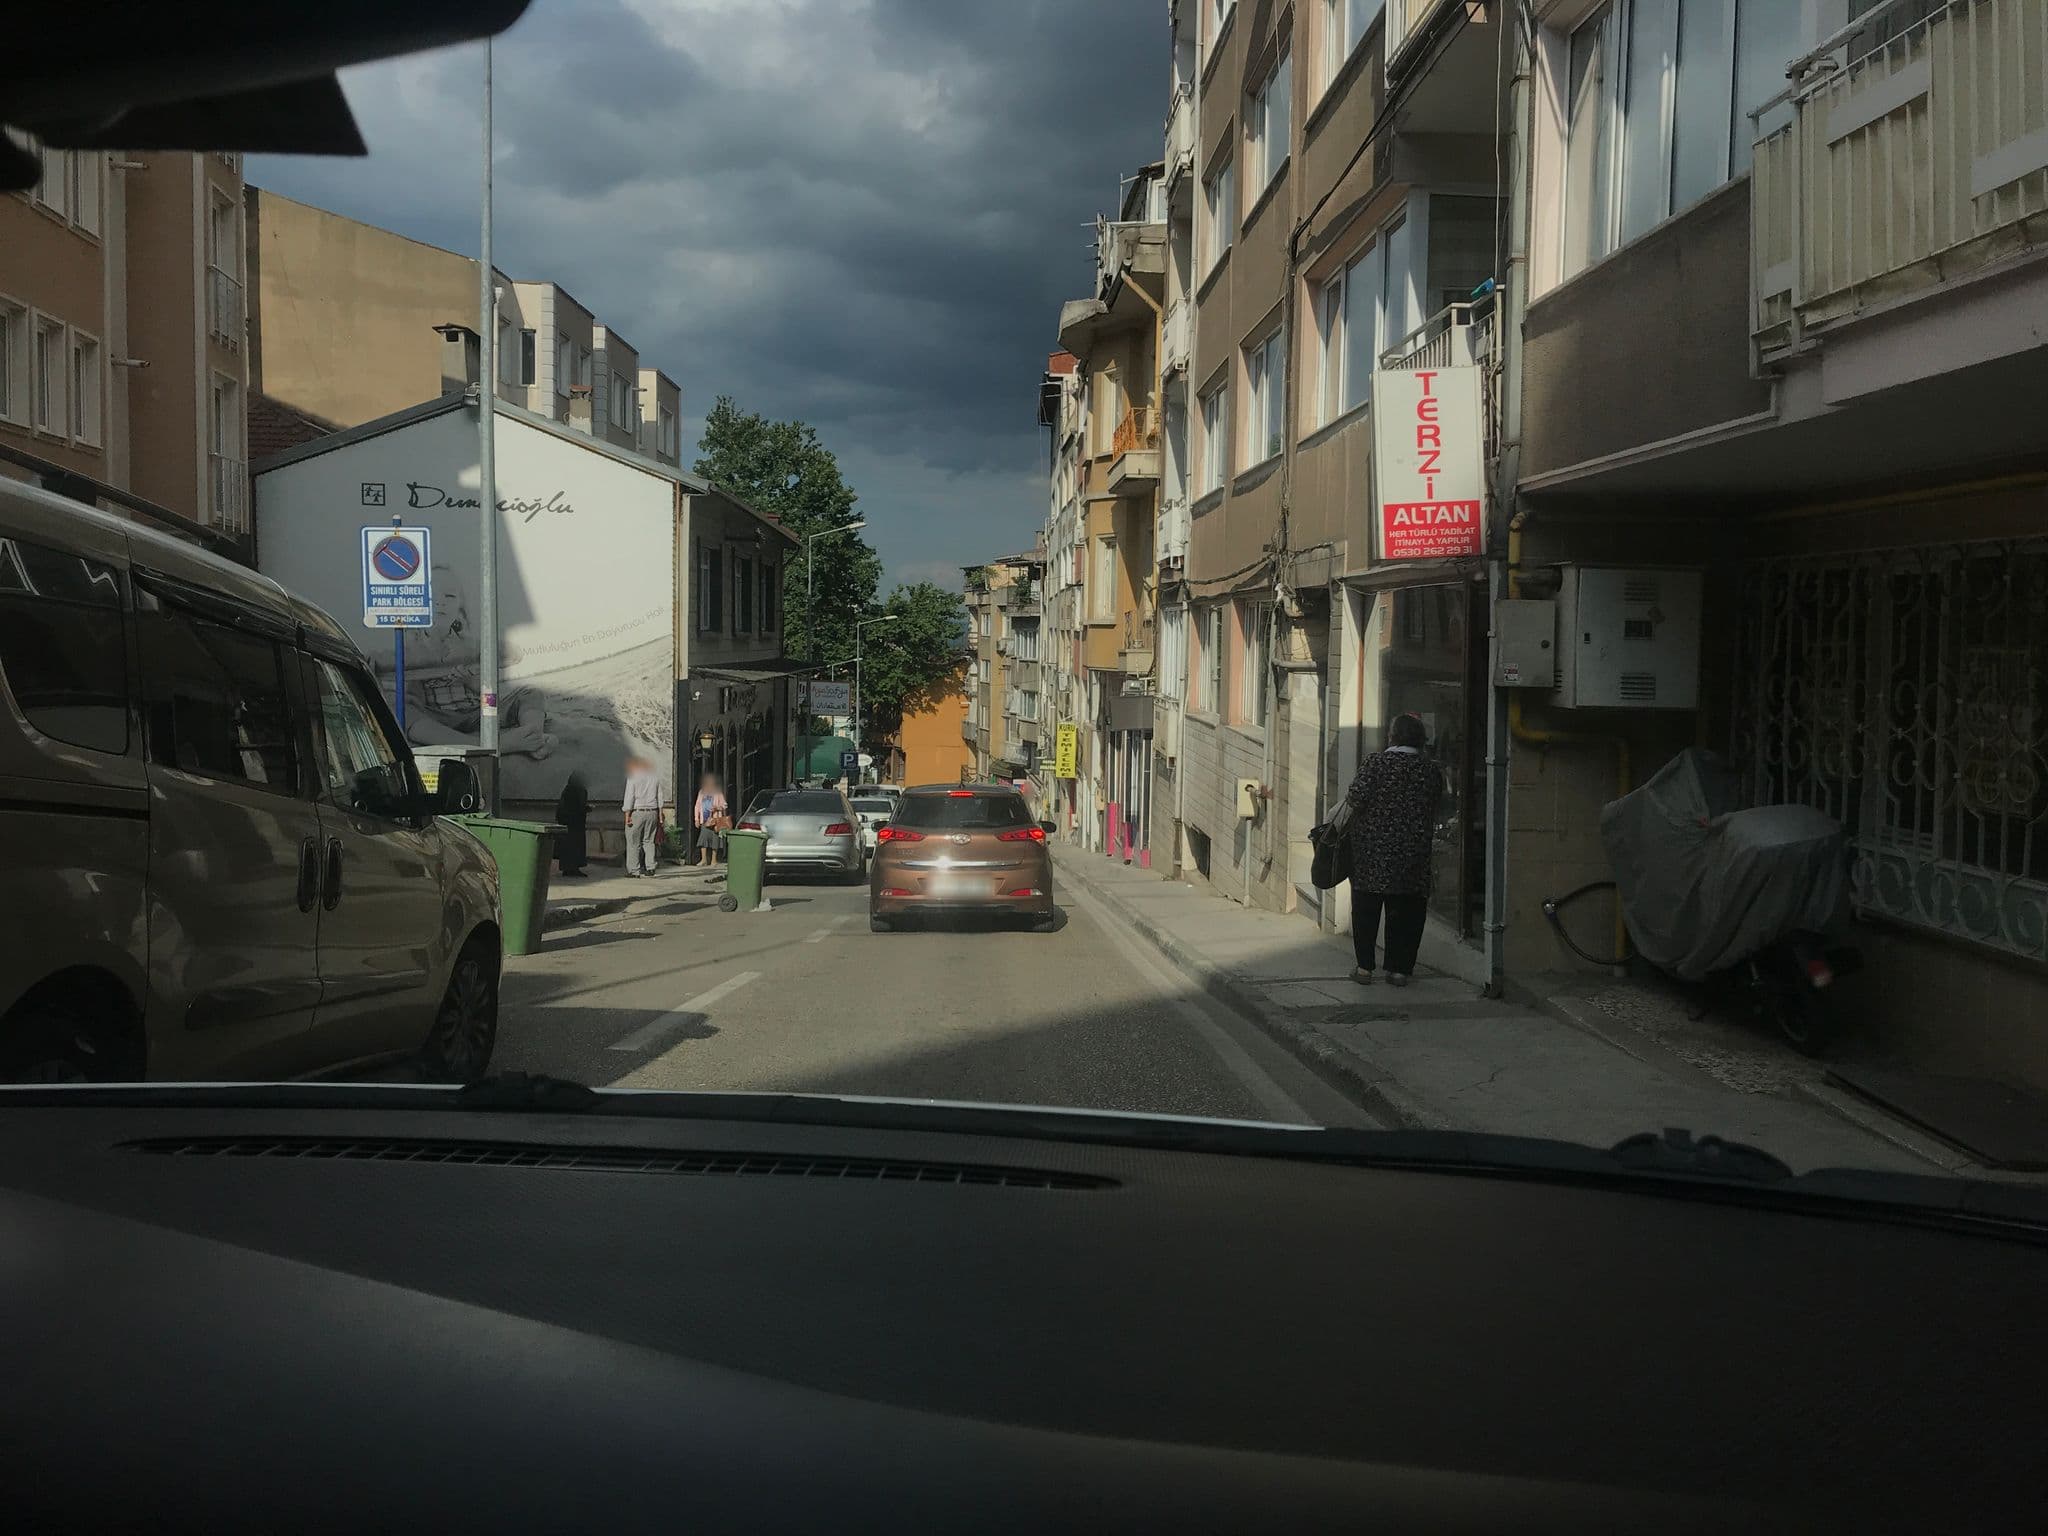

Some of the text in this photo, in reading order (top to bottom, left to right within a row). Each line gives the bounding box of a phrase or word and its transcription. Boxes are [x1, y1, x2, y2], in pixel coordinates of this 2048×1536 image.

[1415, 372, 1441, 500] TERZİ
[406, 482, 574, 523] Demcioğlu
[1393, 504, 1470, 526] ALTAN
[1389, 526, 1476, 538] HER TÜRLÜ TADİLAT
[1395, 538, 1435, 547] İTİNAYLA
[1393, 545, 1473, 557] 0530 262 29 31
[370, 585, 425, 596] SINIRLI SÜRELİ
[372, 596, 424, 606] PARK BÖLGESİ
[390, 614, 421, 623] DAKİKA
[1059, 723, 1076, 732] KURU
